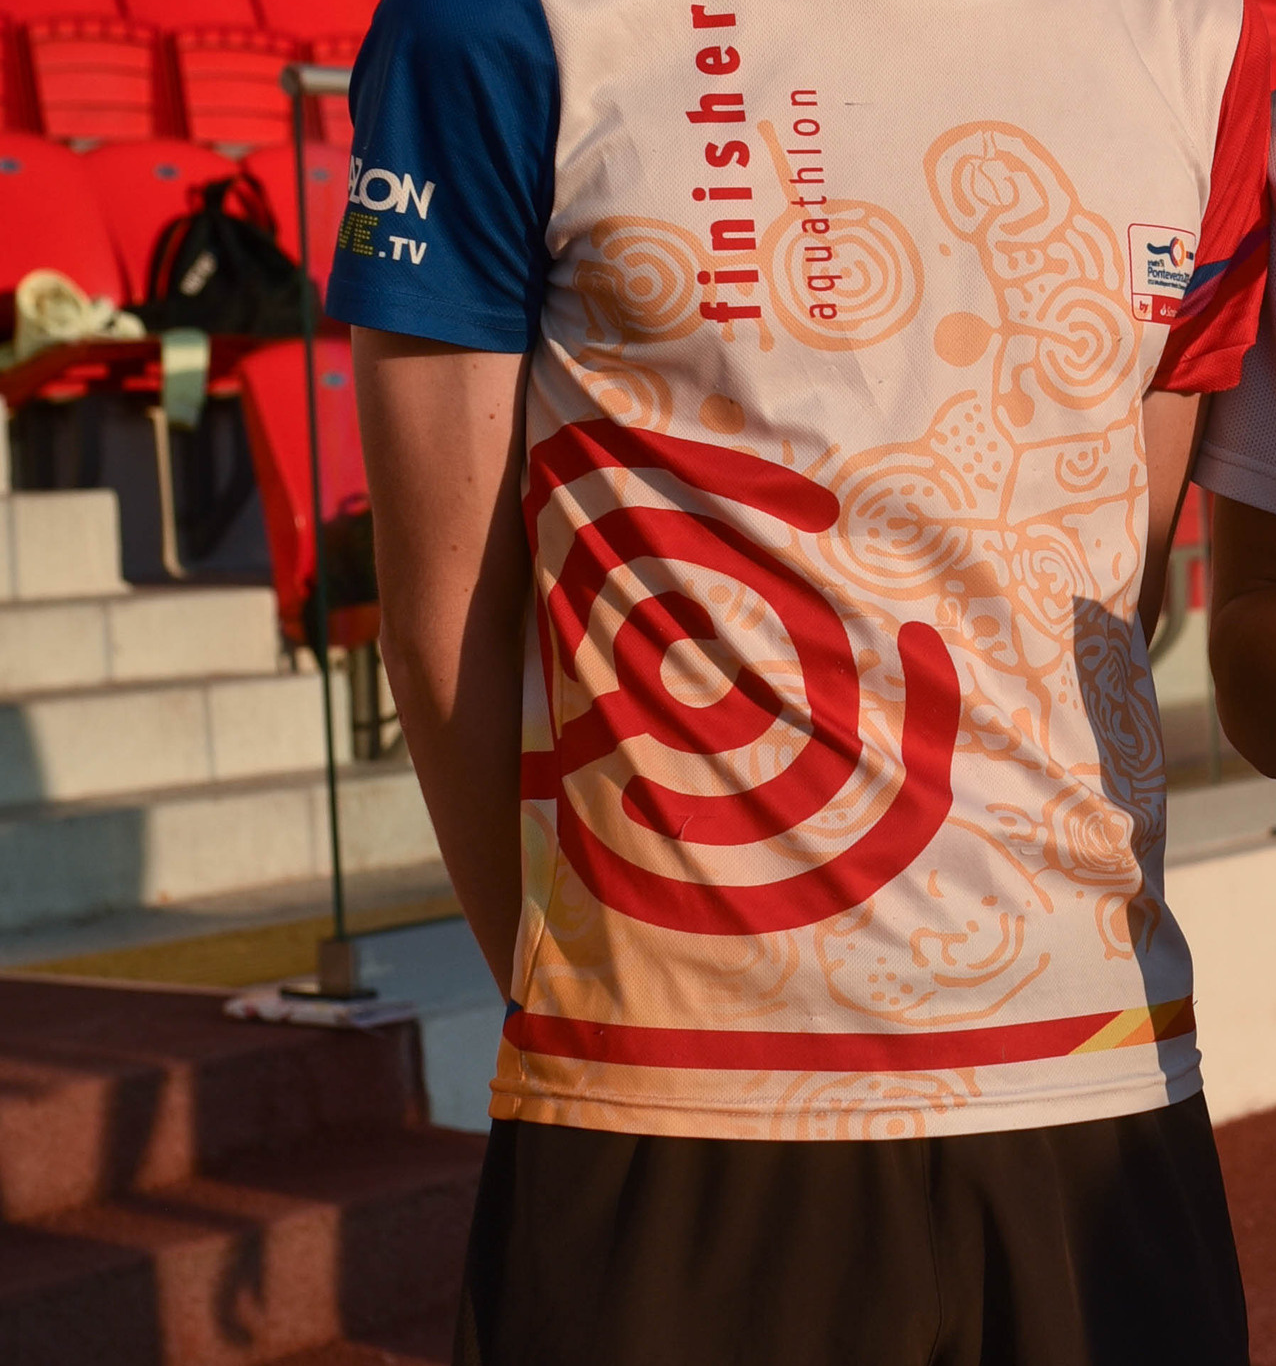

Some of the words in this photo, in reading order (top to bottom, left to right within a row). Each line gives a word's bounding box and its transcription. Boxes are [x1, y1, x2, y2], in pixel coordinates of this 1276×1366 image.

[685, 4, 762, 323] finisher
[786, 89, 843, 320] aquathlon
[1139, 300, 1149, 314] by
